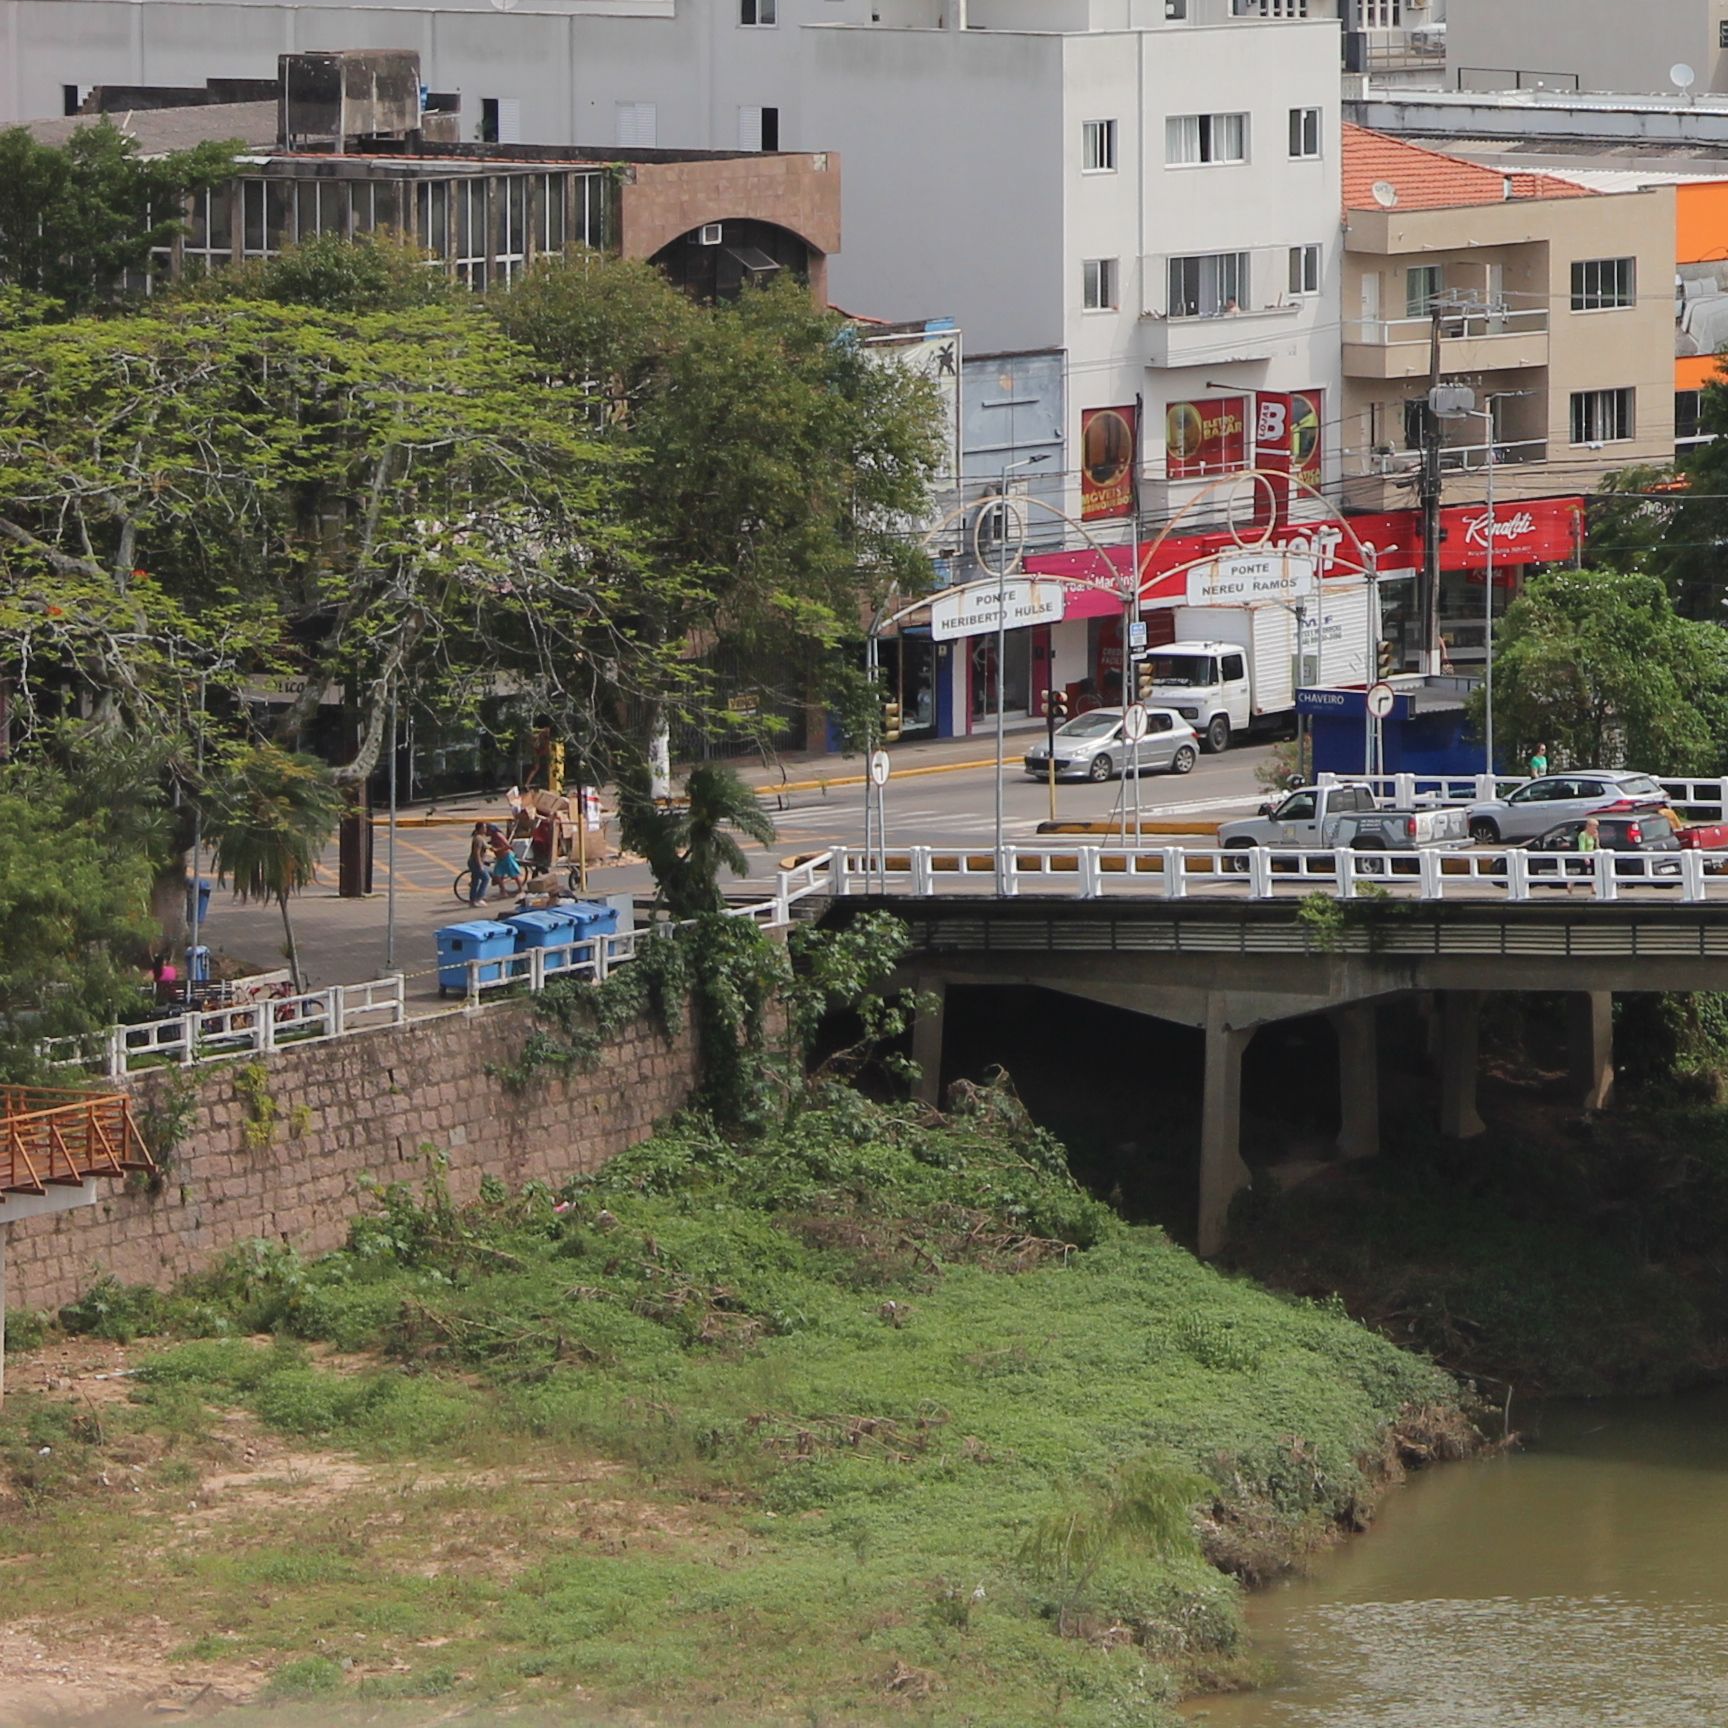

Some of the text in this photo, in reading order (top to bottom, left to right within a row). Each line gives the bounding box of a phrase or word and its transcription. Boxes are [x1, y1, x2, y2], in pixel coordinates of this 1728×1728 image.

[1204, 421, 1243, 440] BAZAR
[1258, 405, 1270, 438] LOJAS
[1231, 562, 1270, 575] PONTE
[1202, 578, 1297, 596] NEREU RAMOS
[976, 590, 1016, 606] PONTE
[941, 610, 1008, 630] HERIBERTO
[1298, 692, 1345, 705] CHAVEIRO
